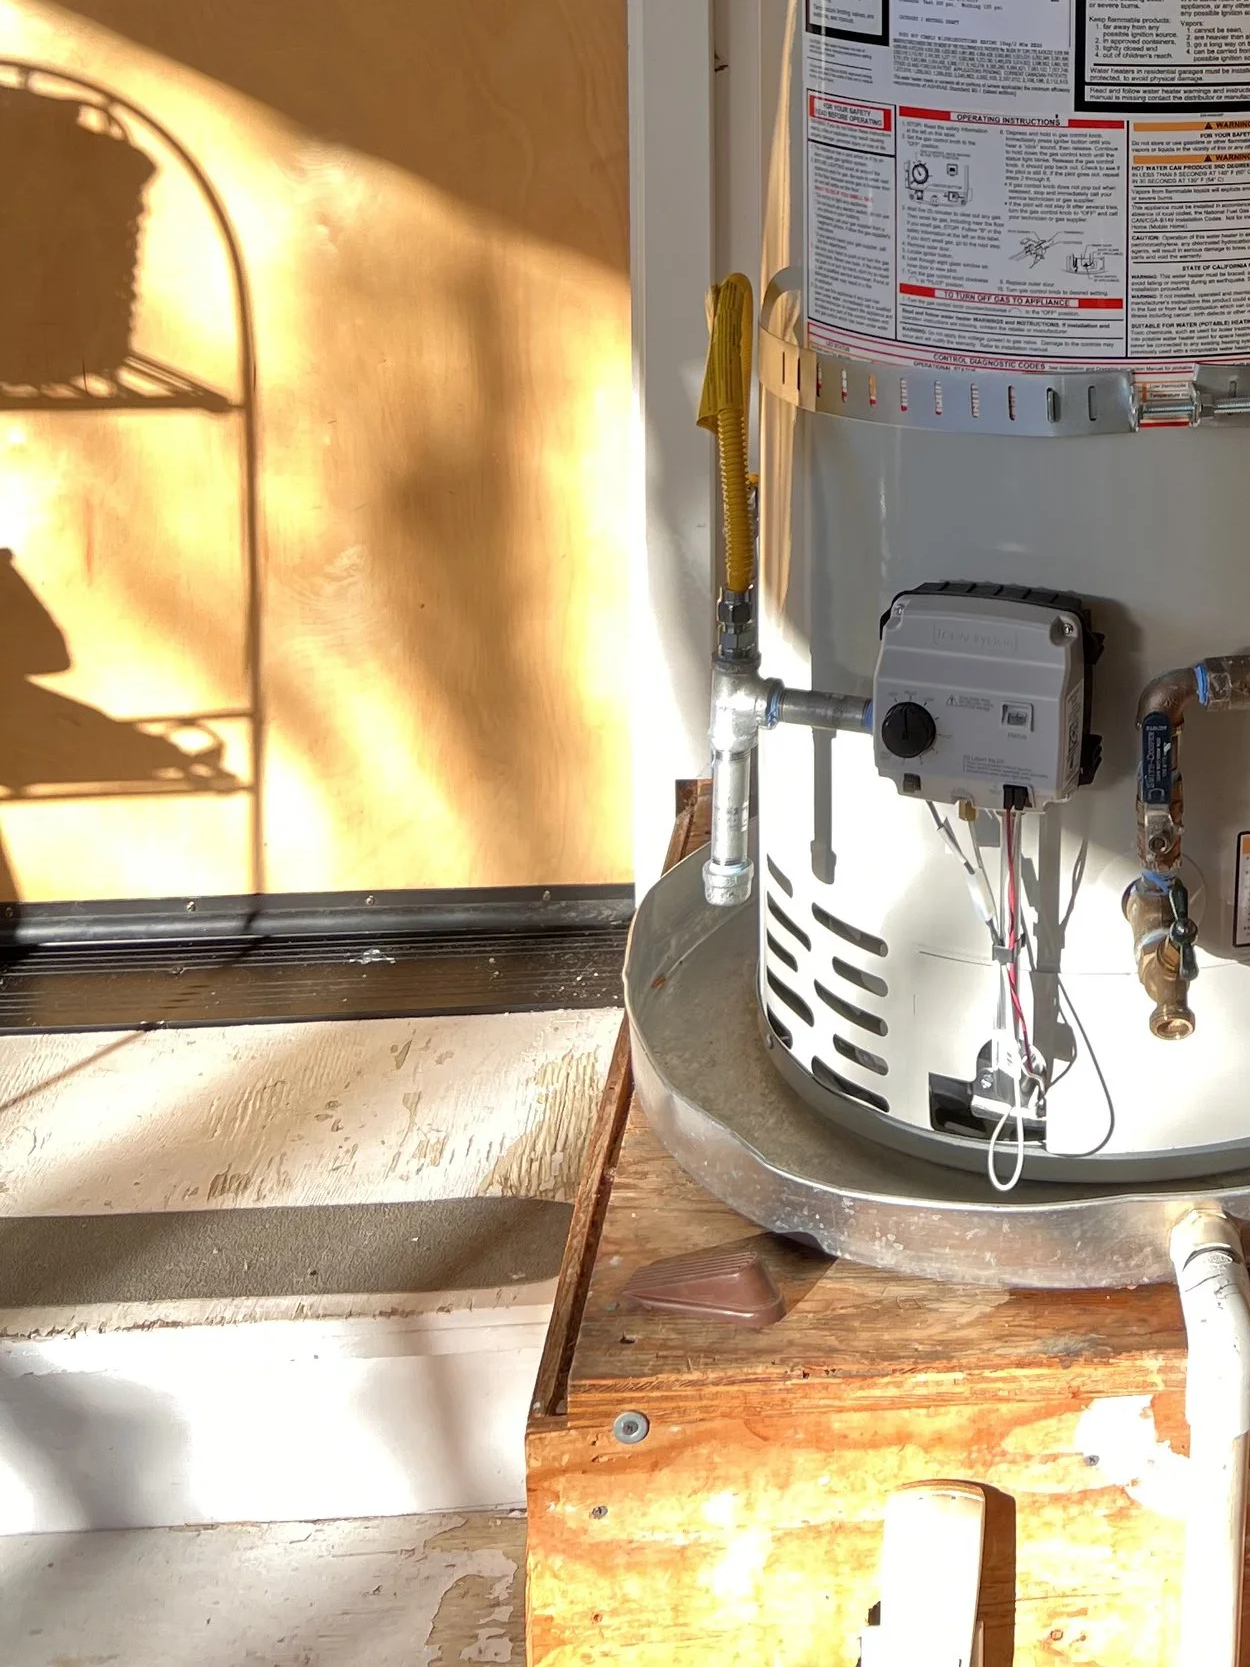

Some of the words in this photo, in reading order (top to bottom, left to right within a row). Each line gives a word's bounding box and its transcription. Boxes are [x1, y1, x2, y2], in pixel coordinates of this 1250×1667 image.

[956, 114, 1000, 124] OPERATING
[1002, 116, 1060, 126] INSTRUCTIONS
[1211, 262, 1247, 270] CALIFORNIA
[943, 291, 955, 299] TO
[954, 292, 975, 301] TURN
[976, 294, 992, 302] OFF
[993, 295, 1010, 304] GAS
[1011, 296, 1023, 304] TO
[1024, 297, 1069, 306] APPLIANCE
[1198, 319, 1230, 327] (POTABLE)
[933, 353, 967, 365] CONTROL
[969, 358, 1016, 368] DIAGNOSTIC
[1017, 361, 1045, 370] CODES
